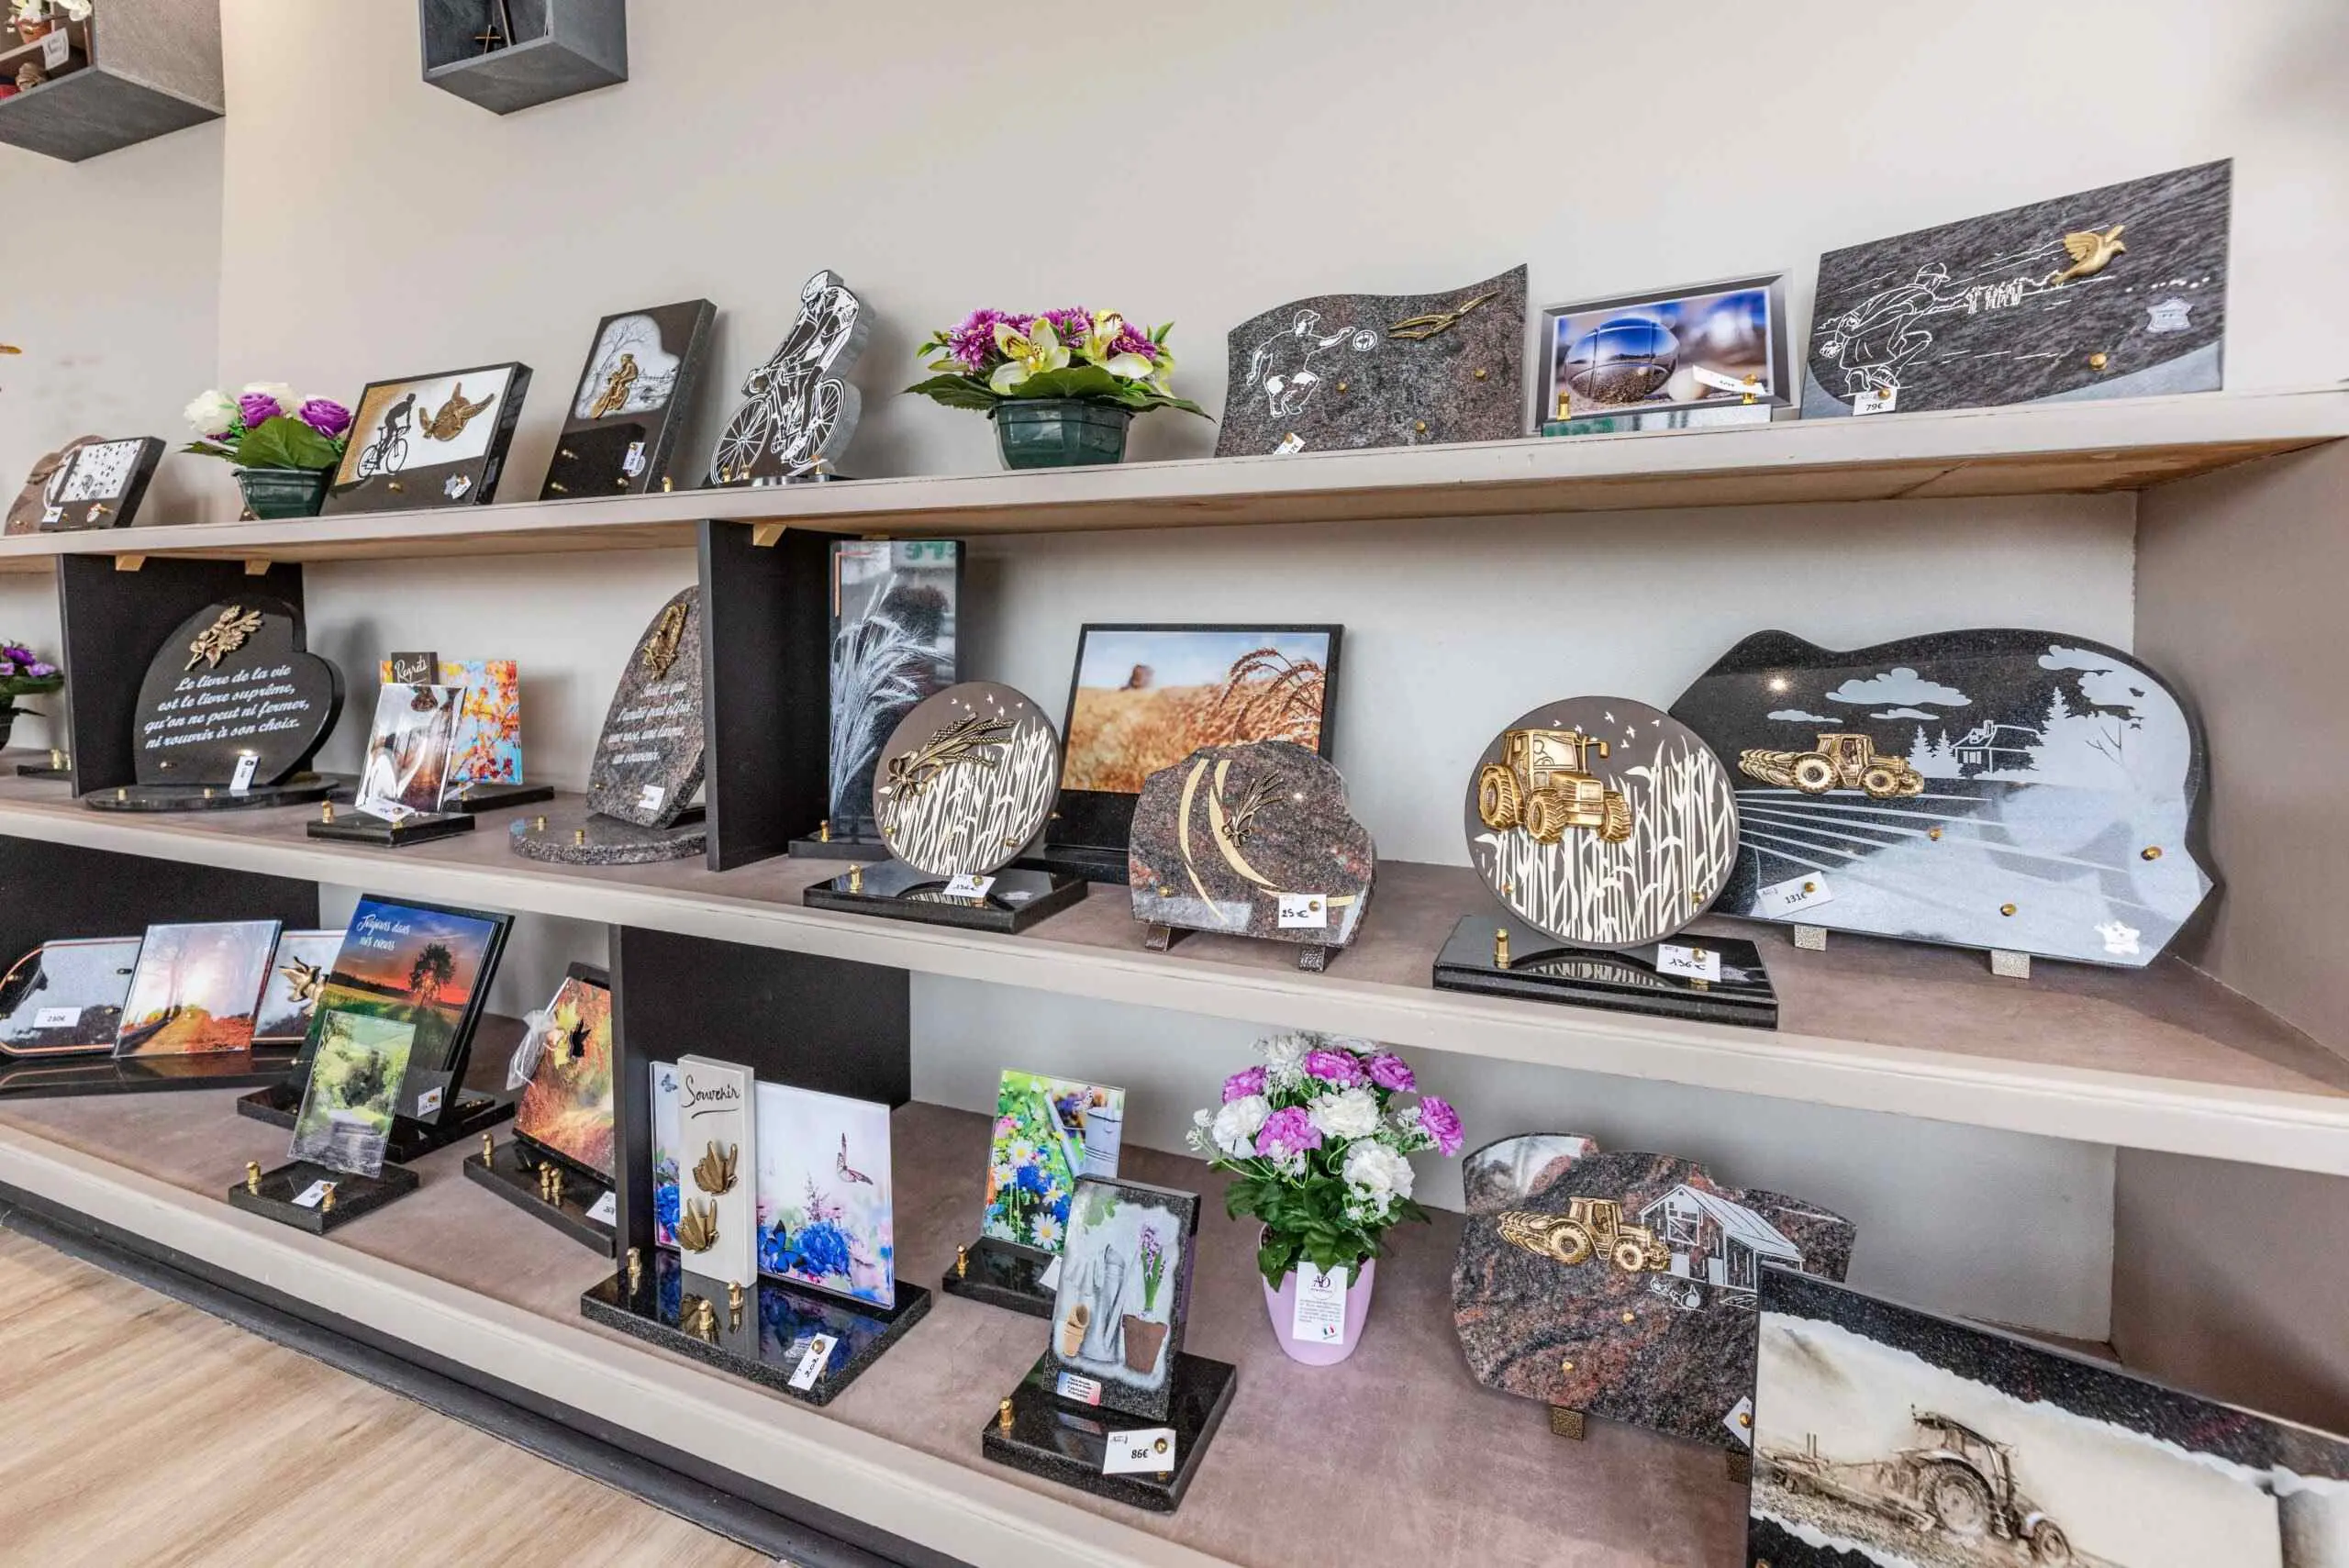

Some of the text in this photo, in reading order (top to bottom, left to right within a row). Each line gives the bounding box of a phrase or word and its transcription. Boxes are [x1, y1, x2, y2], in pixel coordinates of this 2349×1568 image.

[1865, 402, 1883, 411] 79€
[174, 664, 292, 692] Le livre de la vie
[394, 654, 428, 683] Regrets
[157, 683, 295, 711] est le livre suprême,
[143, 699, 310, 734] qu'on ne peut ni fermer,
[145, 717, 300, 750] ni rouvrir à son choix.
[356, 913, 412, 936] Toujours dans
[681, 1073, 740, 1108] Souvenir
[1130, 1448, 1150, 1460] 86€
